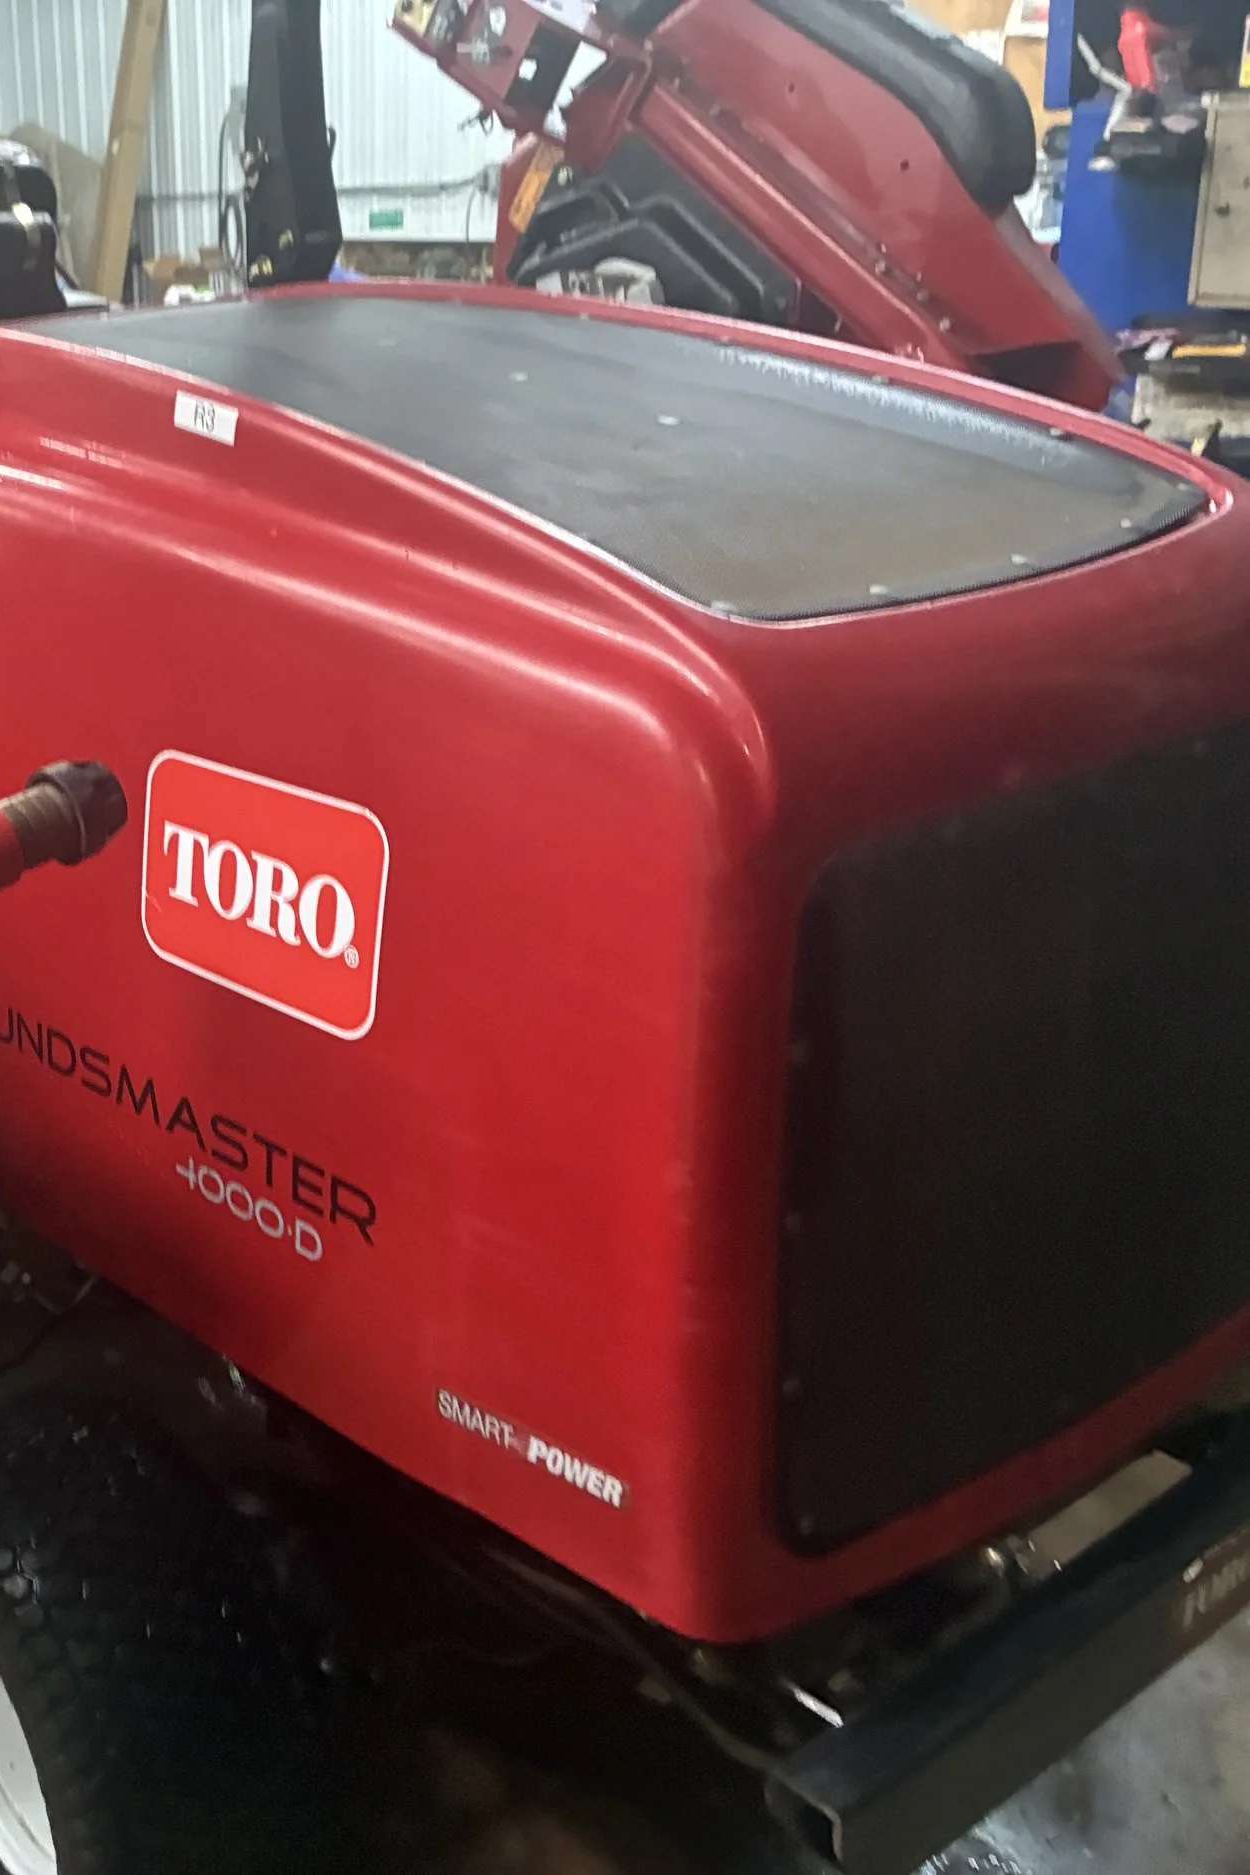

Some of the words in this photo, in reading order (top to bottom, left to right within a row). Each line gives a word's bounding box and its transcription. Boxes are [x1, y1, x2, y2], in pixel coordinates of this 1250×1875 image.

[163, 819, 356, 959] TORO
[438, 1388, 514, 1450] SMART
[526, 1434, 623, 1509] POWER
